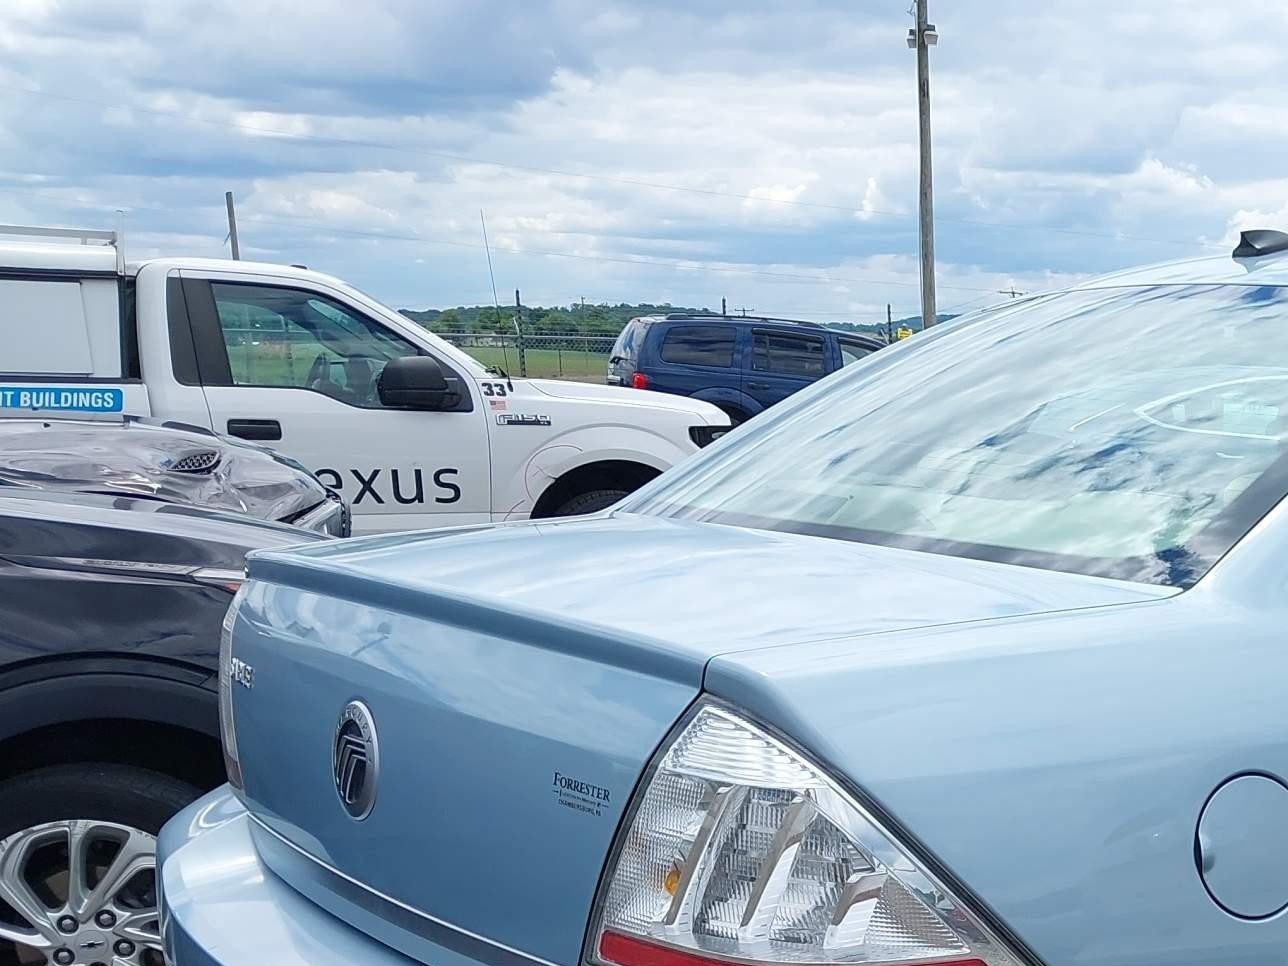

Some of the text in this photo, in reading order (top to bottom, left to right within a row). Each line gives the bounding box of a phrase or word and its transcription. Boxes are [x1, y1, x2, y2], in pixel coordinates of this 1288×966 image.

[481, 382, 507, 397] 33
[0, 391, 114, 408] T BUILDINGS
[553, 771, 610, 803] FORRESTER
